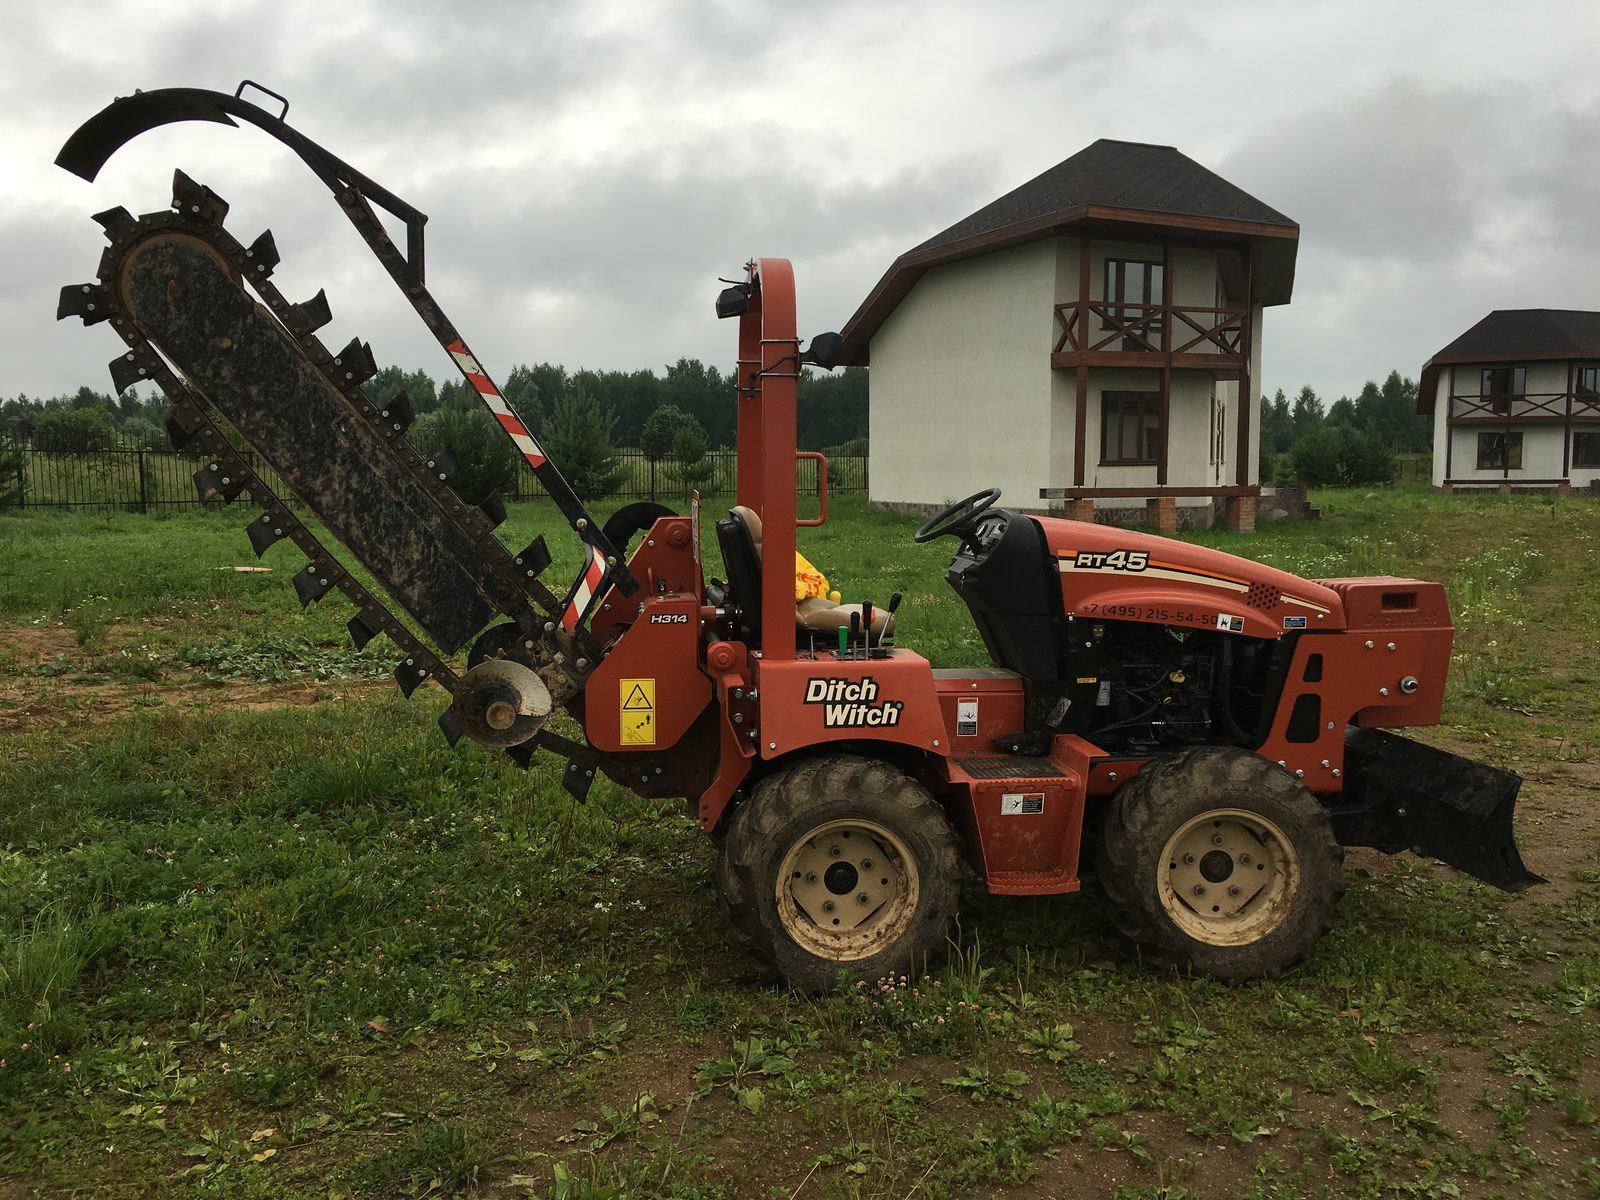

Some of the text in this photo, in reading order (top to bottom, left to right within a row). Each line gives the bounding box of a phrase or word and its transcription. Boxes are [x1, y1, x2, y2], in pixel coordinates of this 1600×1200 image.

[1076, 550, 1149, 570] RT45
[650, 614, 688, 624] H314
[1083, 603, 1099, 613] +7
[1102, 604, 1143, 619] (495)
[805, 678, 877, 702] Ditch
